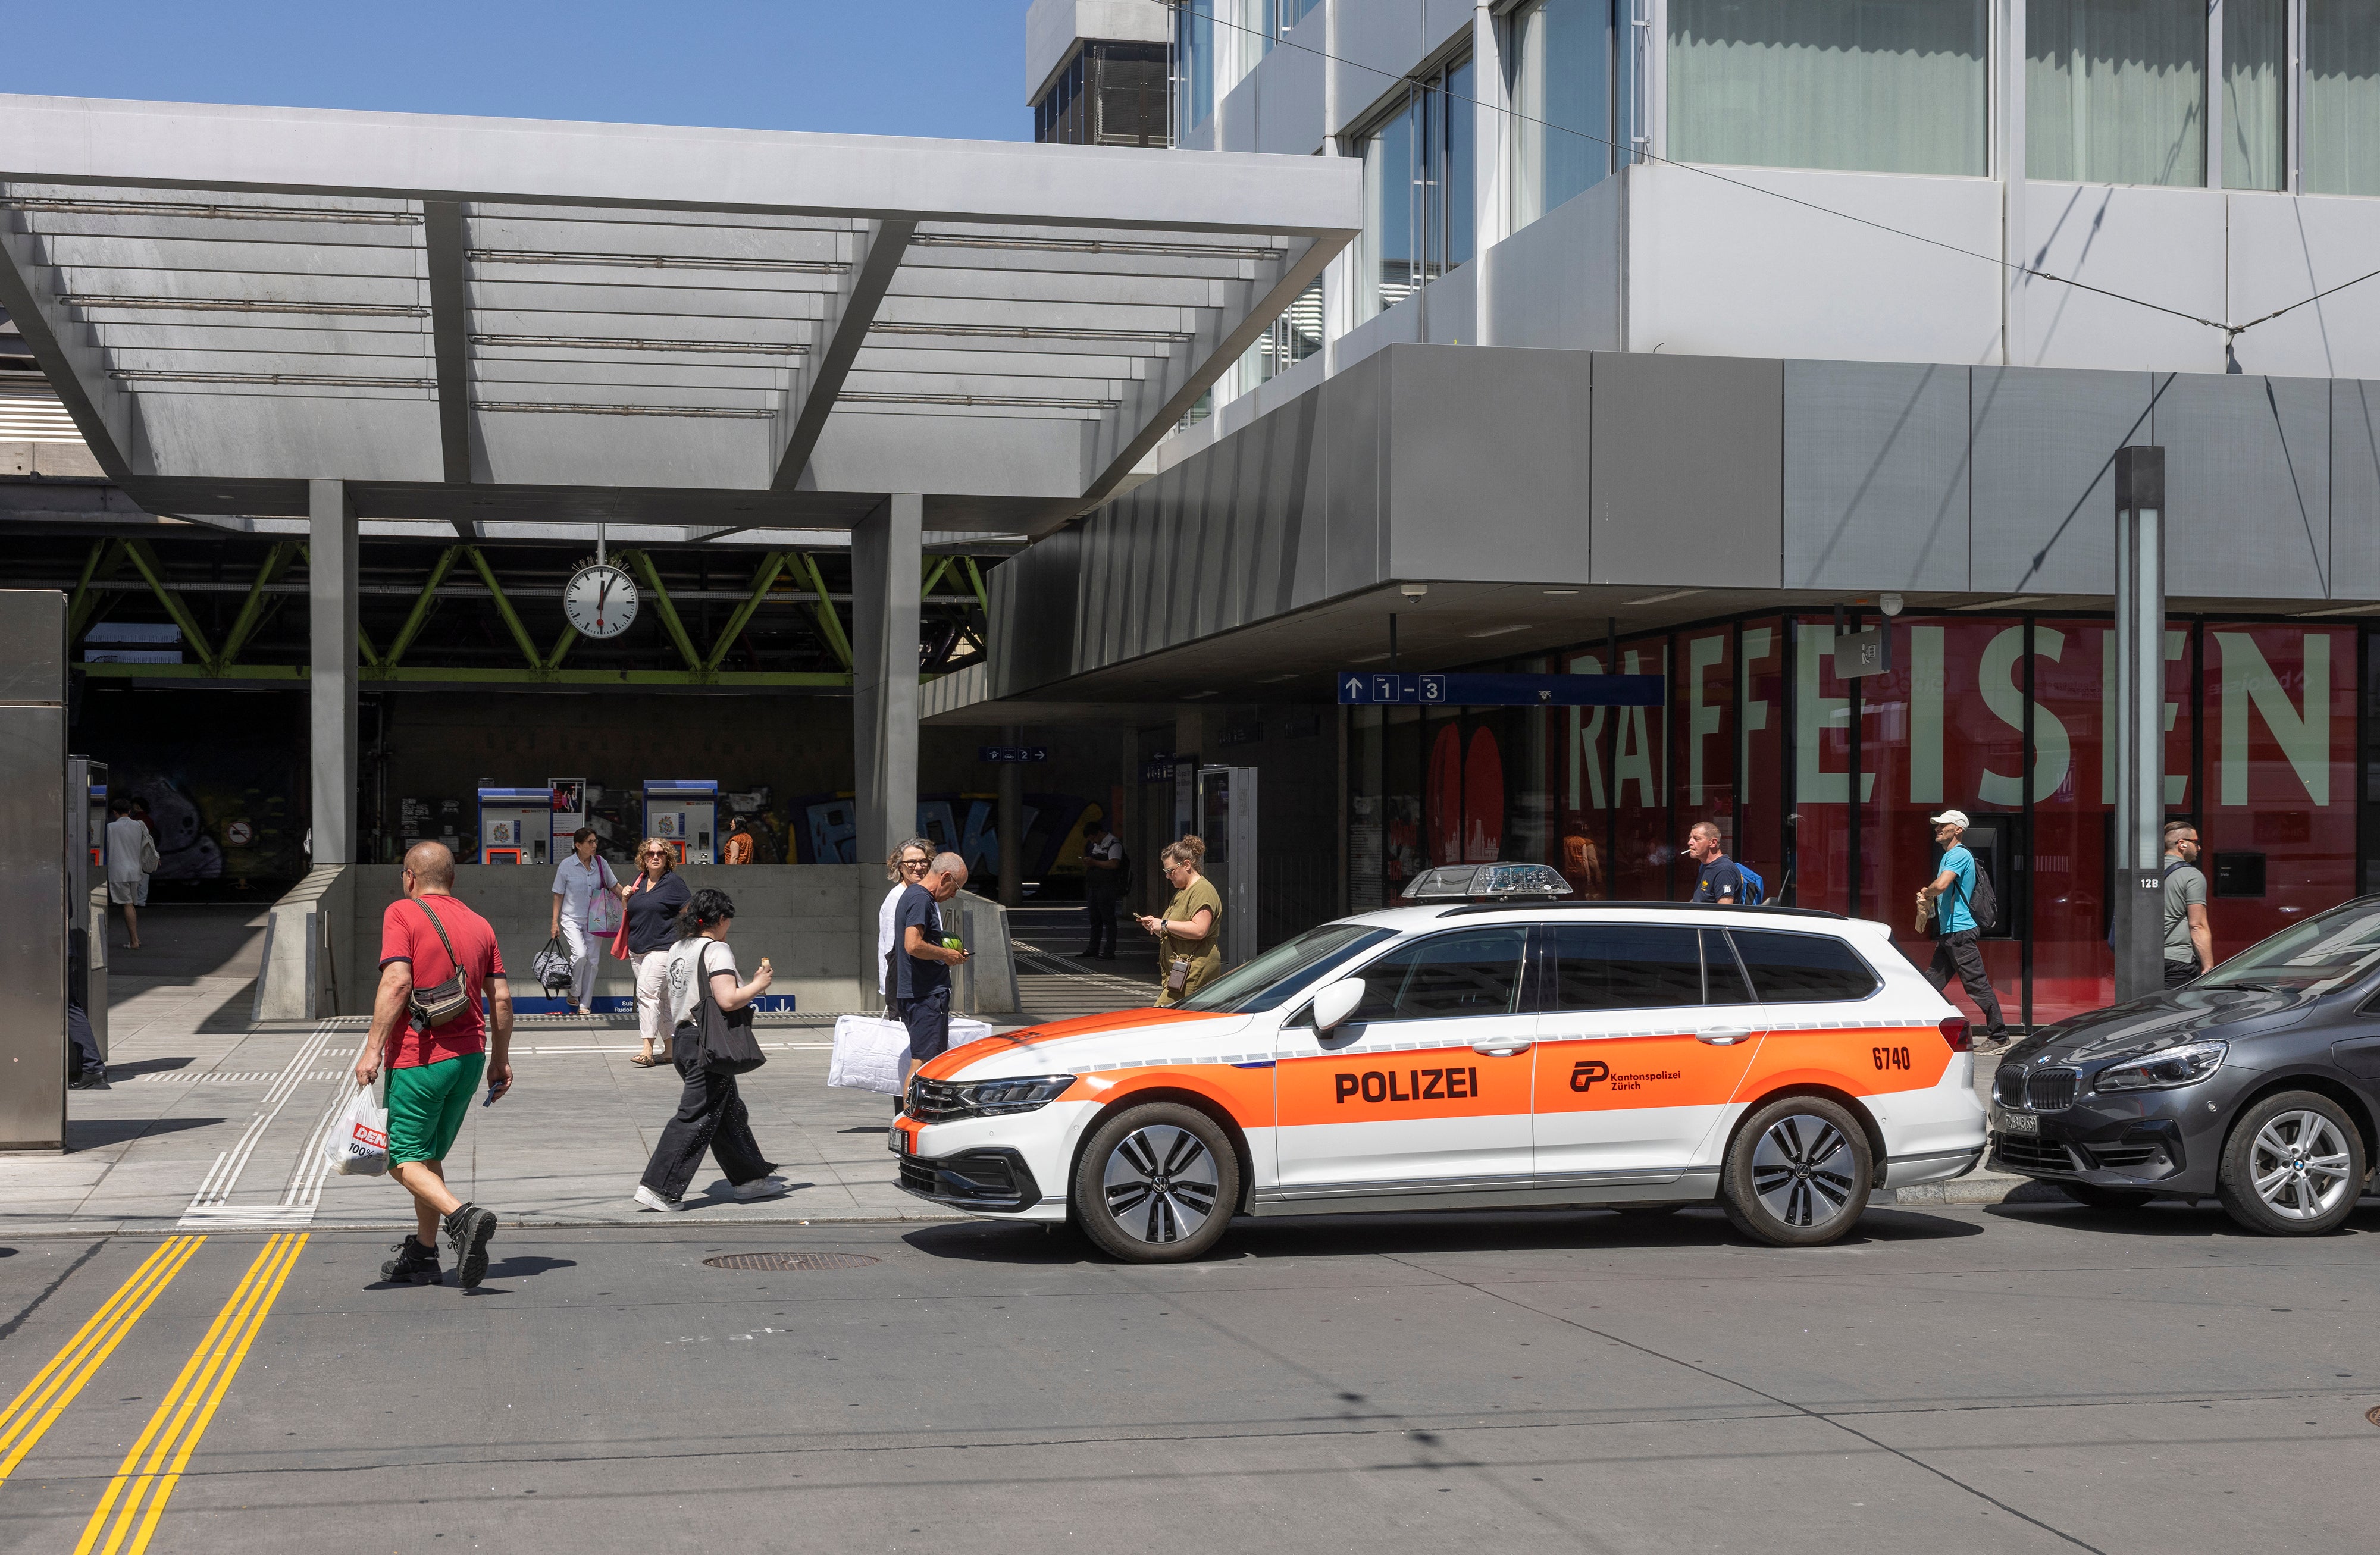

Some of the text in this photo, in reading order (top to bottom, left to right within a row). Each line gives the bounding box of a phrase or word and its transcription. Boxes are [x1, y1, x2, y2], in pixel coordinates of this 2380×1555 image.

[1382, 682, 1389, 698] 1
[1426, 682, 1438, 699] 3
[1021, 751, 1028, 760] 2
[2141, 879, 2159, 888] 12B
[1872, 1046, 1911, 1070] 6740
[1610, 1070, 1681, 1082] Kantonspolizei
[1335, 1067, 1479, 1104] POLIZEI
[1611, 1081, 1641, 1091] Zürich
[355, 1127, 387, 1148] DEN
[348, 1142, 375, 1159] 100%
